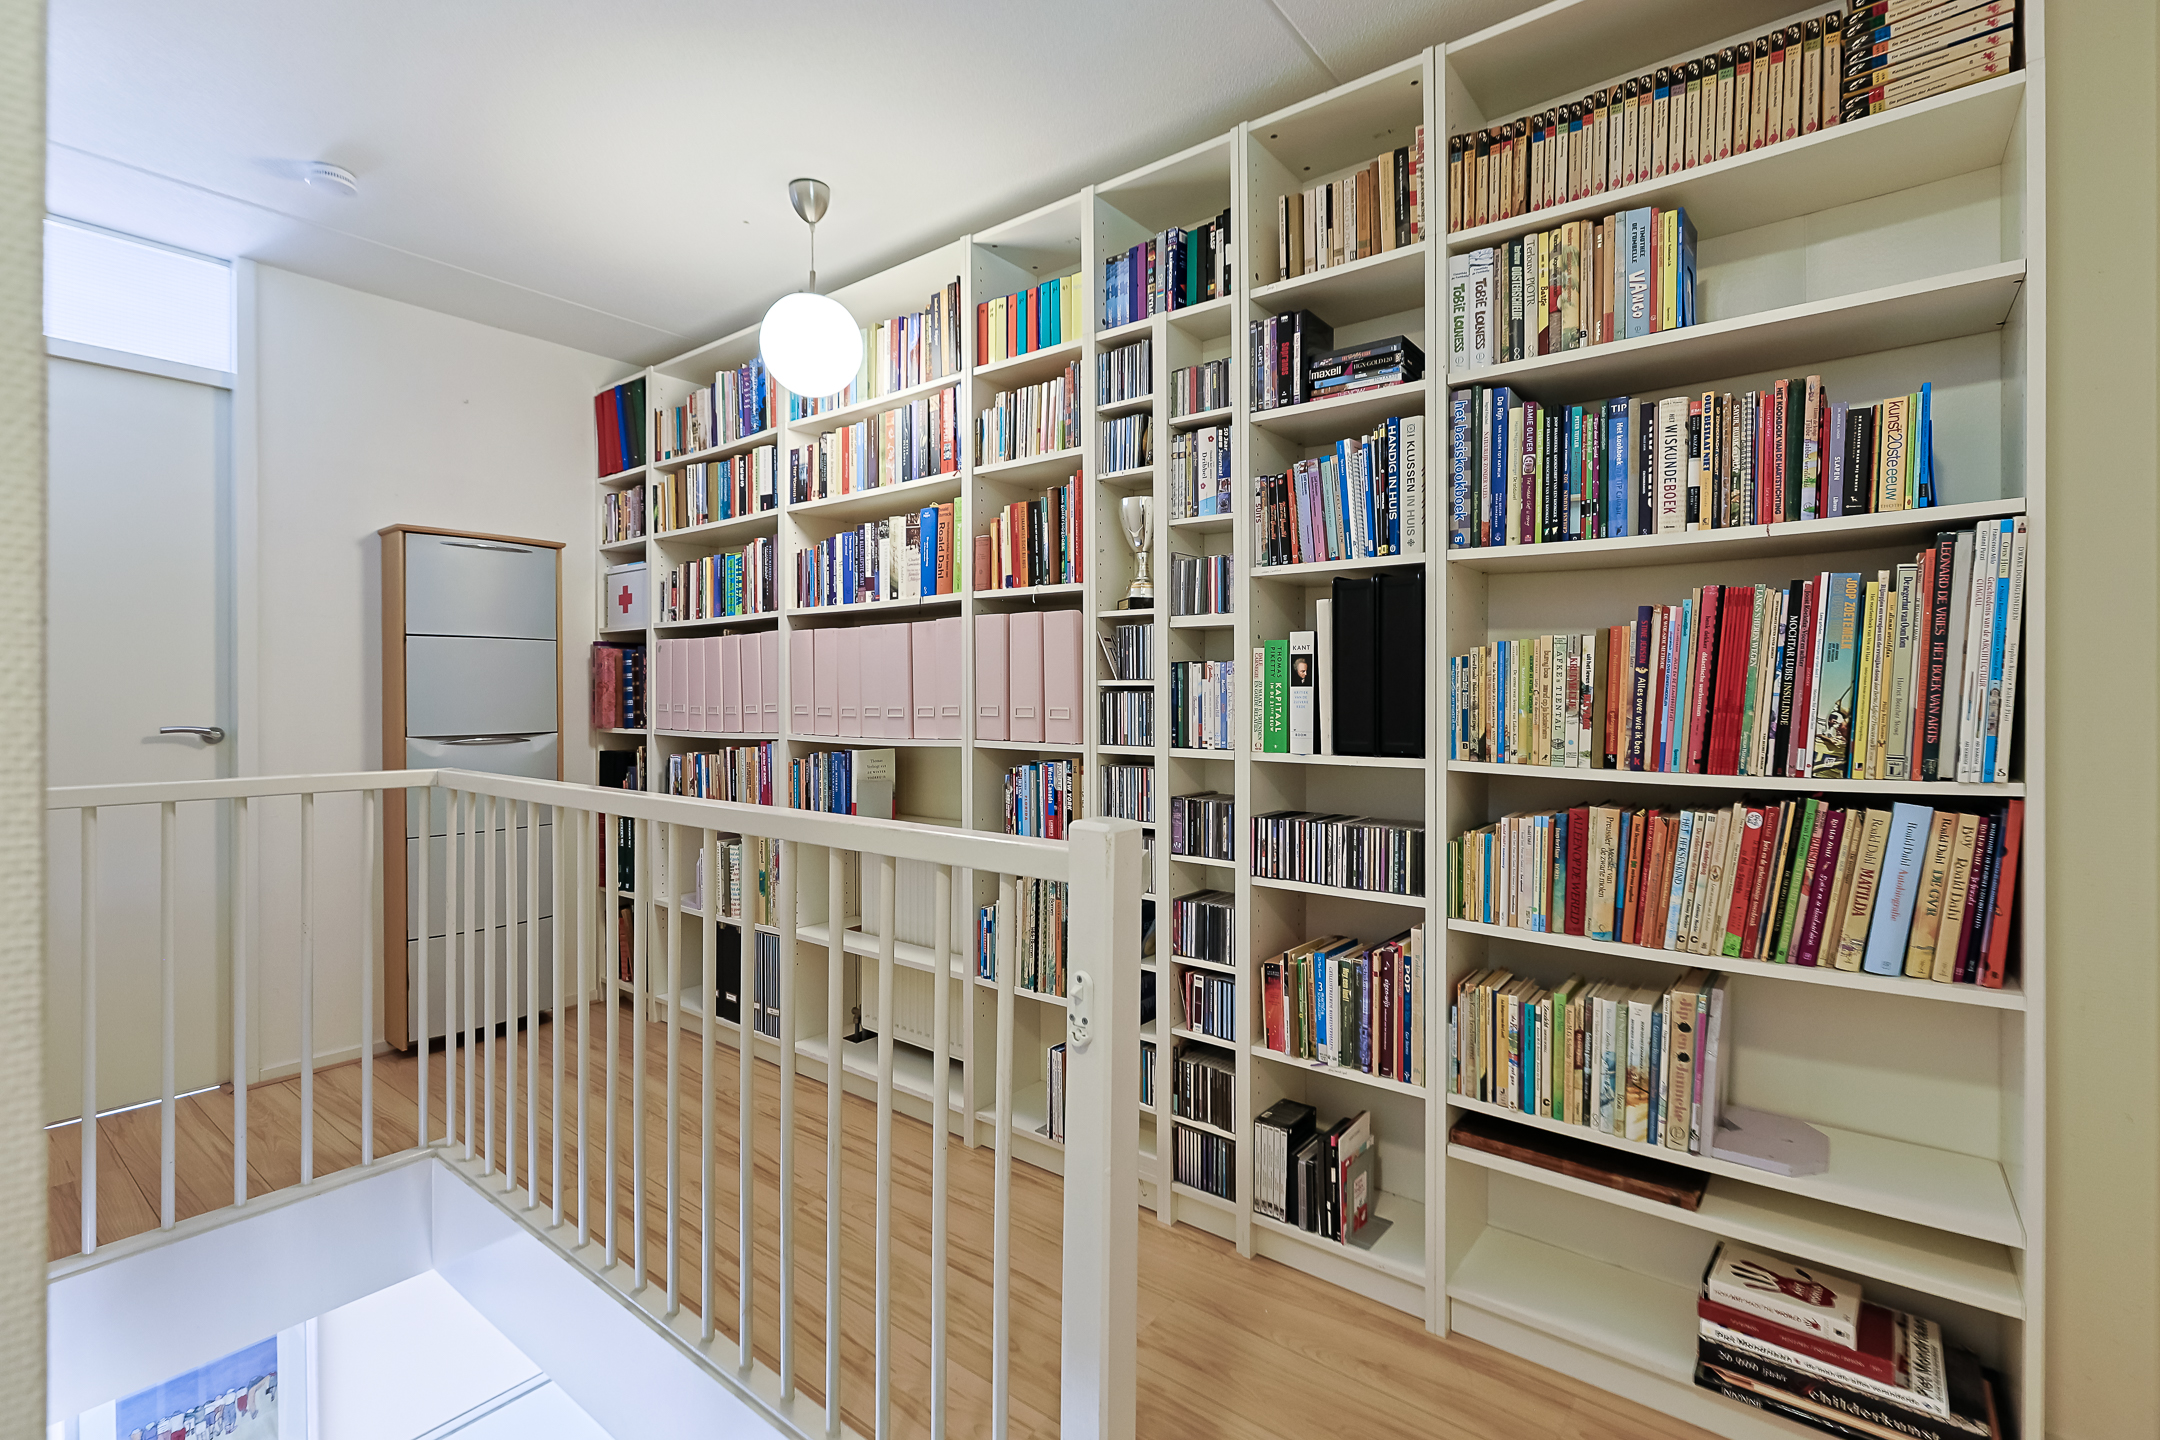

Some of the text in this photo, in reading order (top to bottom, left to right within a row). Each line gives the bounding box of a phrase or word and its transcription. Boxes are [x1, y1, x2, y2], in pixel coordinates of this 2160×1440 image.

[1311, 365, 1342, 380] maxell
[1388, 425, 1397, 520] HANDIG IN HUIS
[1406, 441, 1415, 493] KLUSSEN
[1454, 401, 1468, 521] het basiskookboek
[1663, 424, 1678, 514] WISKUNDEBOEK
[1833, 456, 1841, 481] SLAPEN
[1406, 510, 1415, 536] HUIS
[1841, 577, 1858, 649] JOOP ZOETEMELK
[1639, 639, 1647, 663] JENSEN
[1927, 541, 1952, 744] LEONARD DE VRIES HET BOEK VAN ARTIS
[1780, 615, 1798, 725] MOCHTAR LUBIS INSULINDE
[1637, 677, 1646, 697] Alles
[1554, 686, 1563, 730] TIENTAL
[1635, 698, 1643, 714] over
[1634, 716, 1643, 730] wie
[1635, 731, 1642, 739] ik
[1604, 817, 1614, 846] Preussler
[1939, 818, 1952, 843] Roald
[1852, 818, 1884, 916] Roald Dahl MATILDA
[1934, 843, 1949, 864] Dahl
[1890, 822, 1918, 921] Roald Dahl Autobiografie
[1947, 826, 1975, 921] Boy Roald Dahl
[1597, 878, 1606, 898] molen
